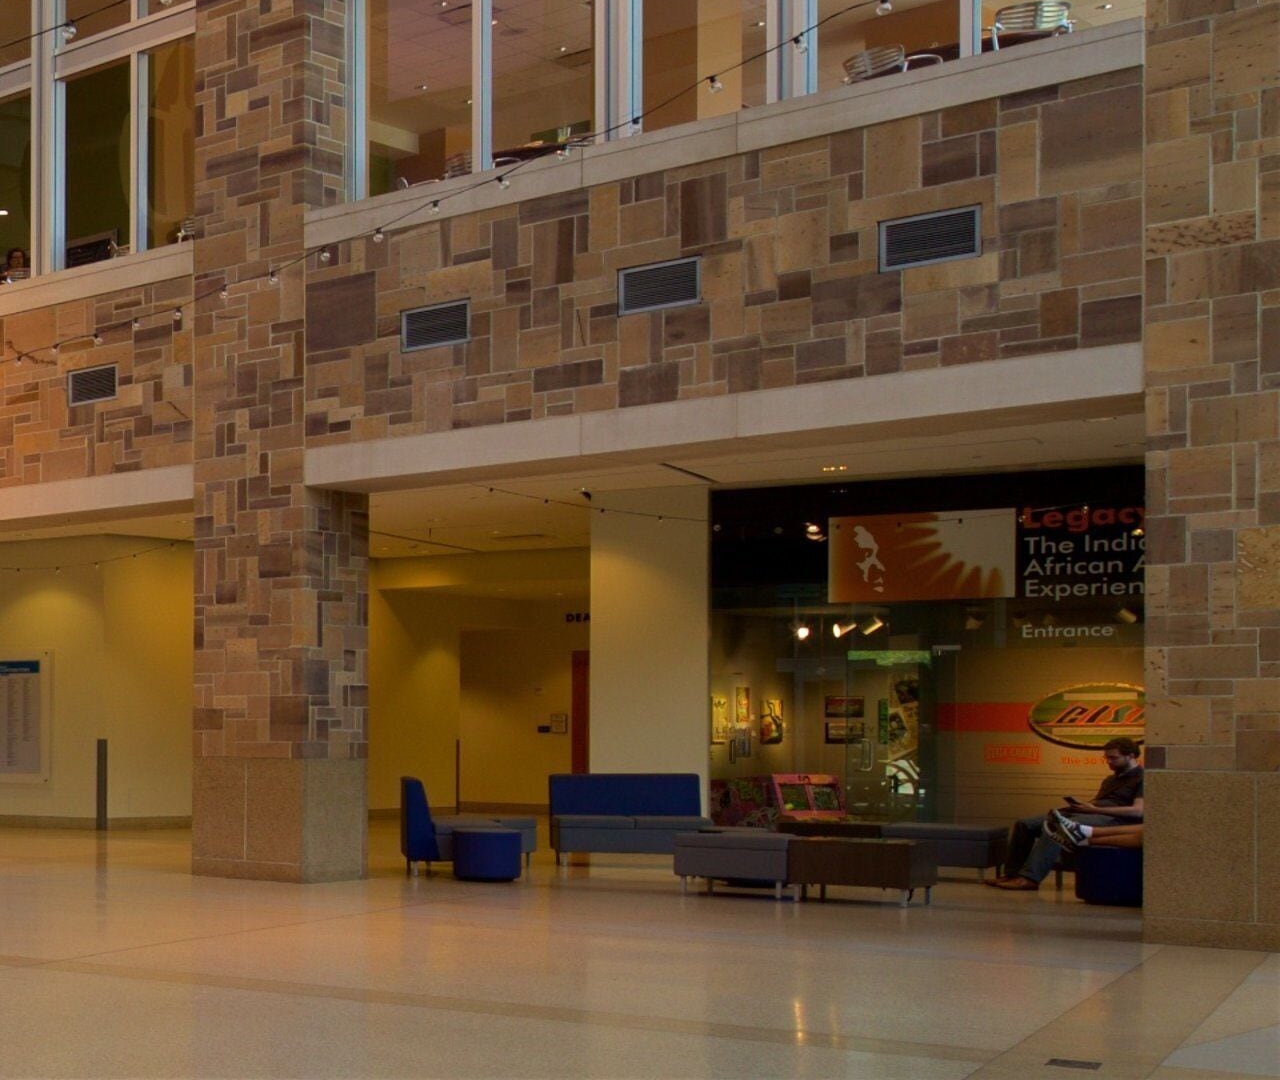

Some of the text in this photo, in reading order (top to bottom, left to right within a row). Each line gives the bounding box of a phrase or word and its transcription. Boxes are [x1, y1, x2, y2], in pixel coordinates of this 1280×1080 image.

[1023, 535, 1075, 555] The
[1023, 556, 1124, 576] African
[1022, 624, 1114, 638] Entrance
